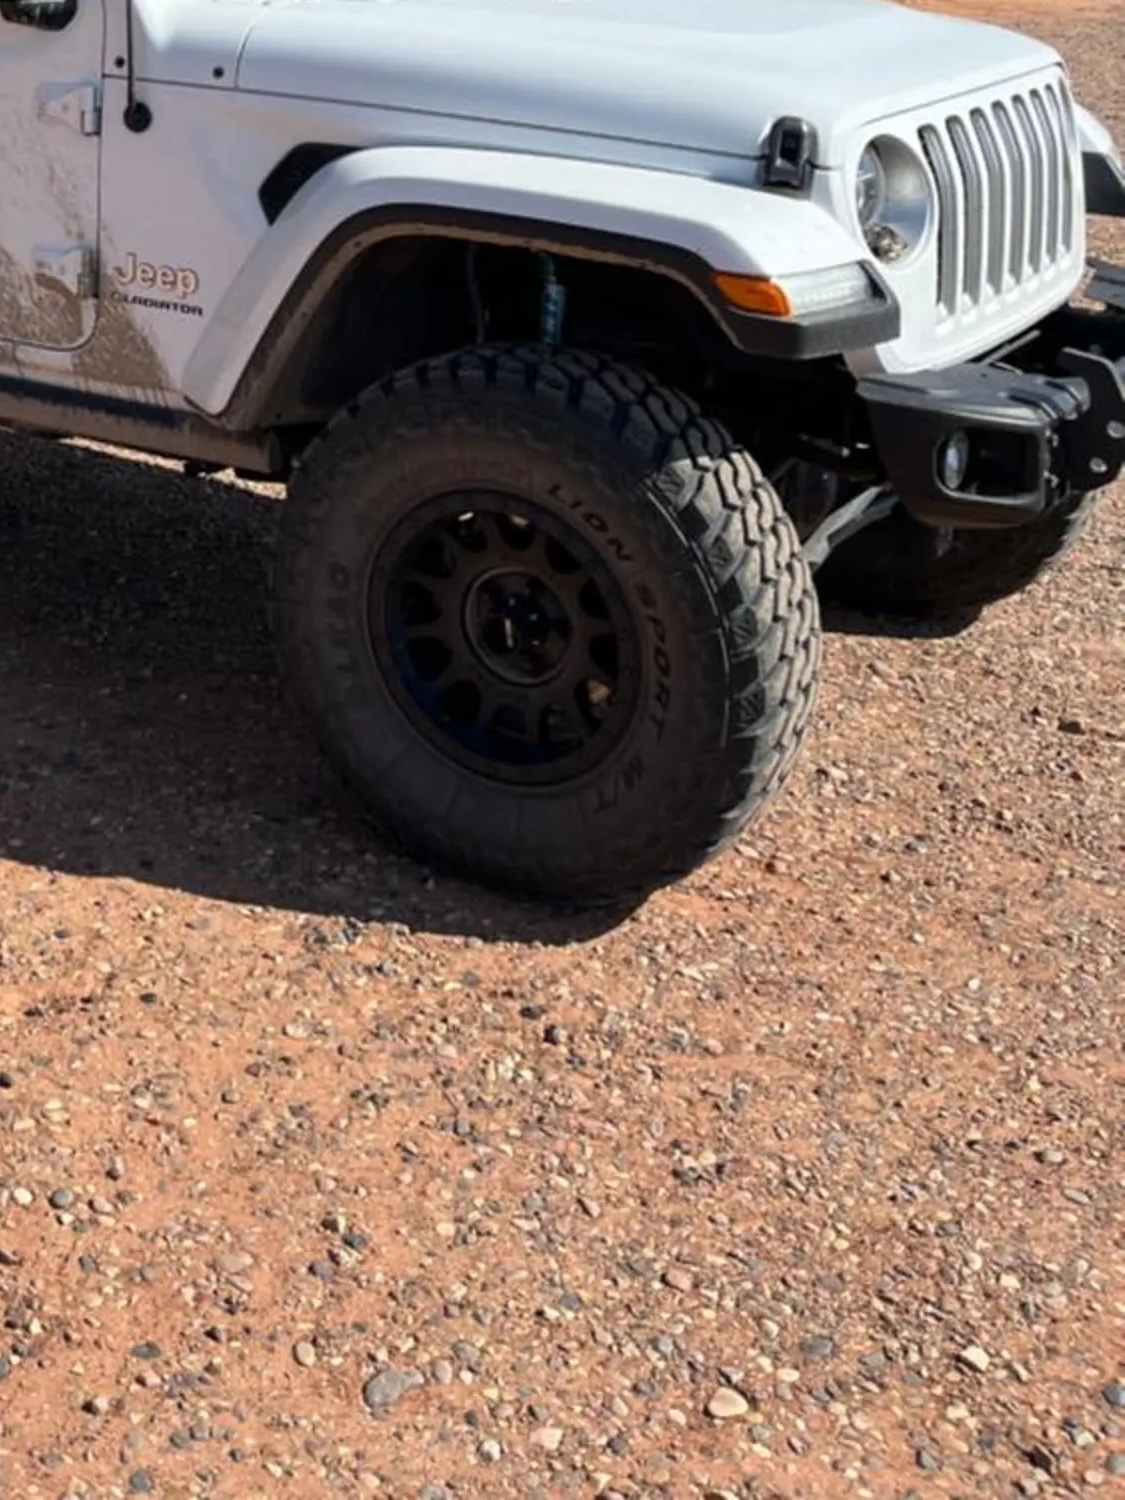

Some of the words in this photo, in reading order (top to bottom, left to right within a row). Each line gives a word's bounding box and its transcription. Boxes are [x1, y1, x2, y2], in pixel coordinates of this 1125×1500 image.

[114, 251, 200, 299] Jeep
[546, 482, 634, 564] LION
[636, 583, 672, 741] SPORT
